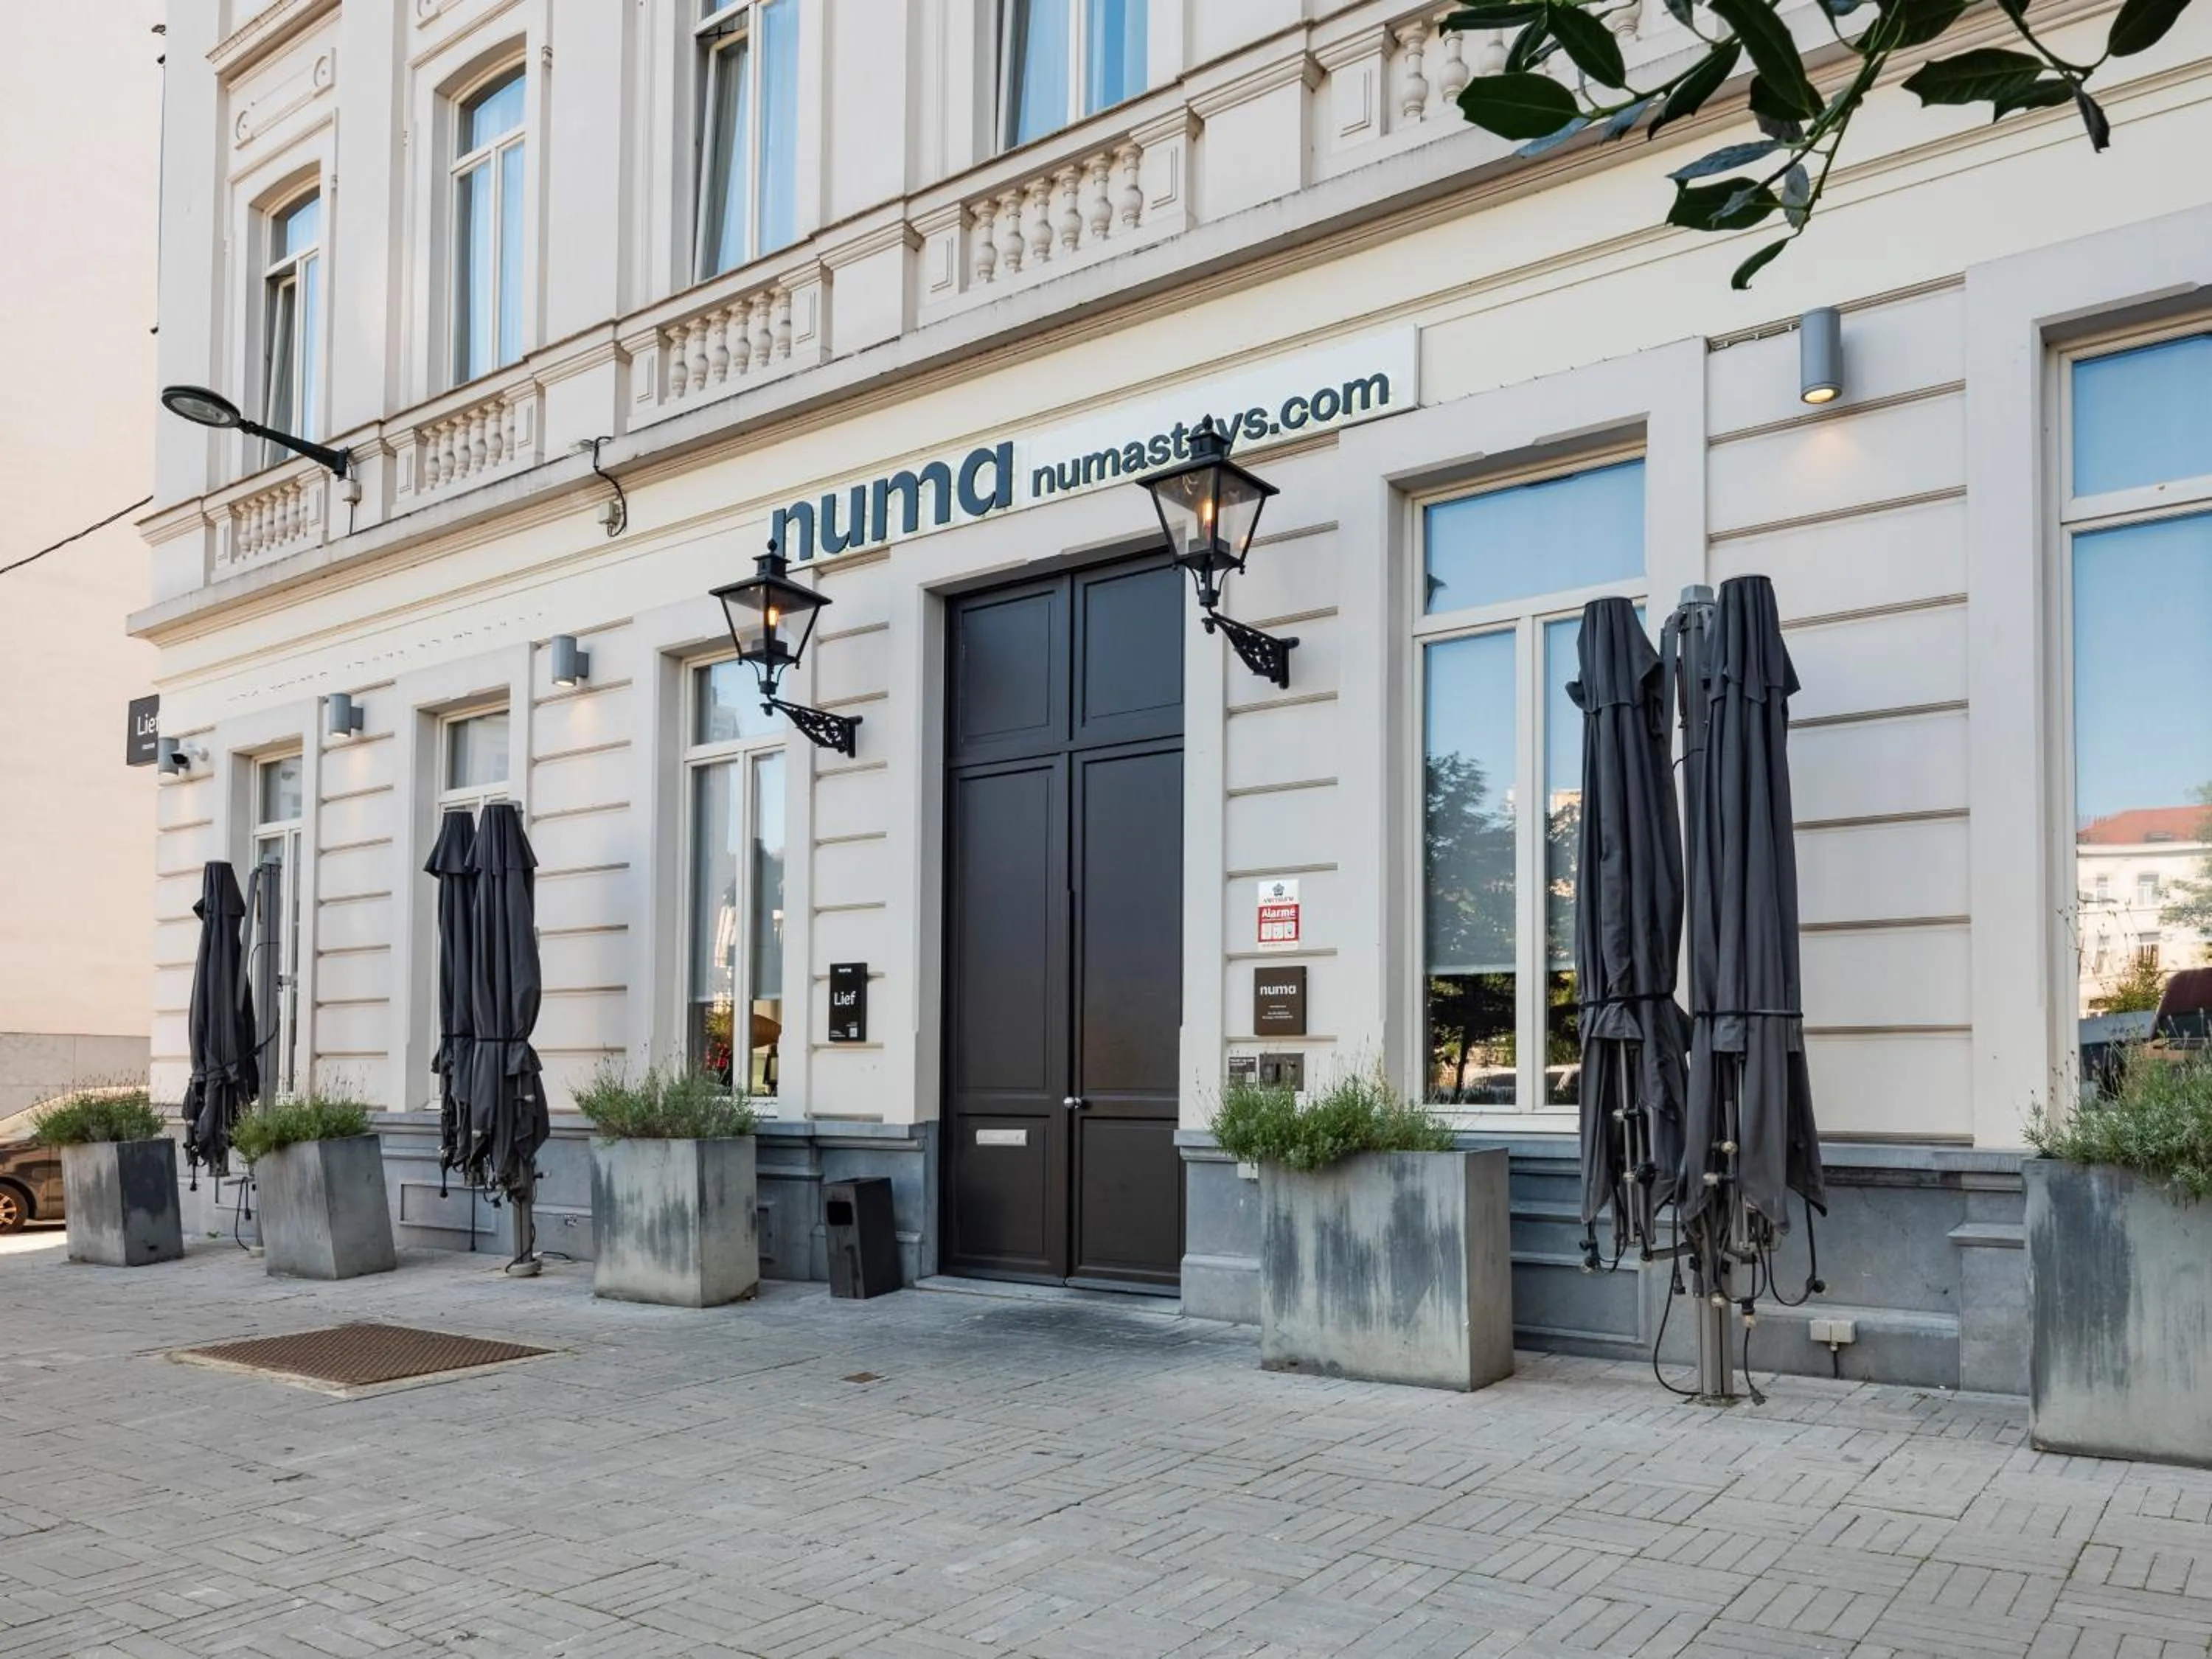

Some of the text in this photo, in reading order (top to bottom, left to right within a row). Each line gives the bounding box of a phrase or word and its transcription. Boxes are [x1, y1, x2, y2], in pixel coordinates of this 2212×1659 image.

[772, 372, 1390, 561] numa numastys.com
[1259, 984, 1296, 995] numa
[834, 990, 856, 1006] Lief
